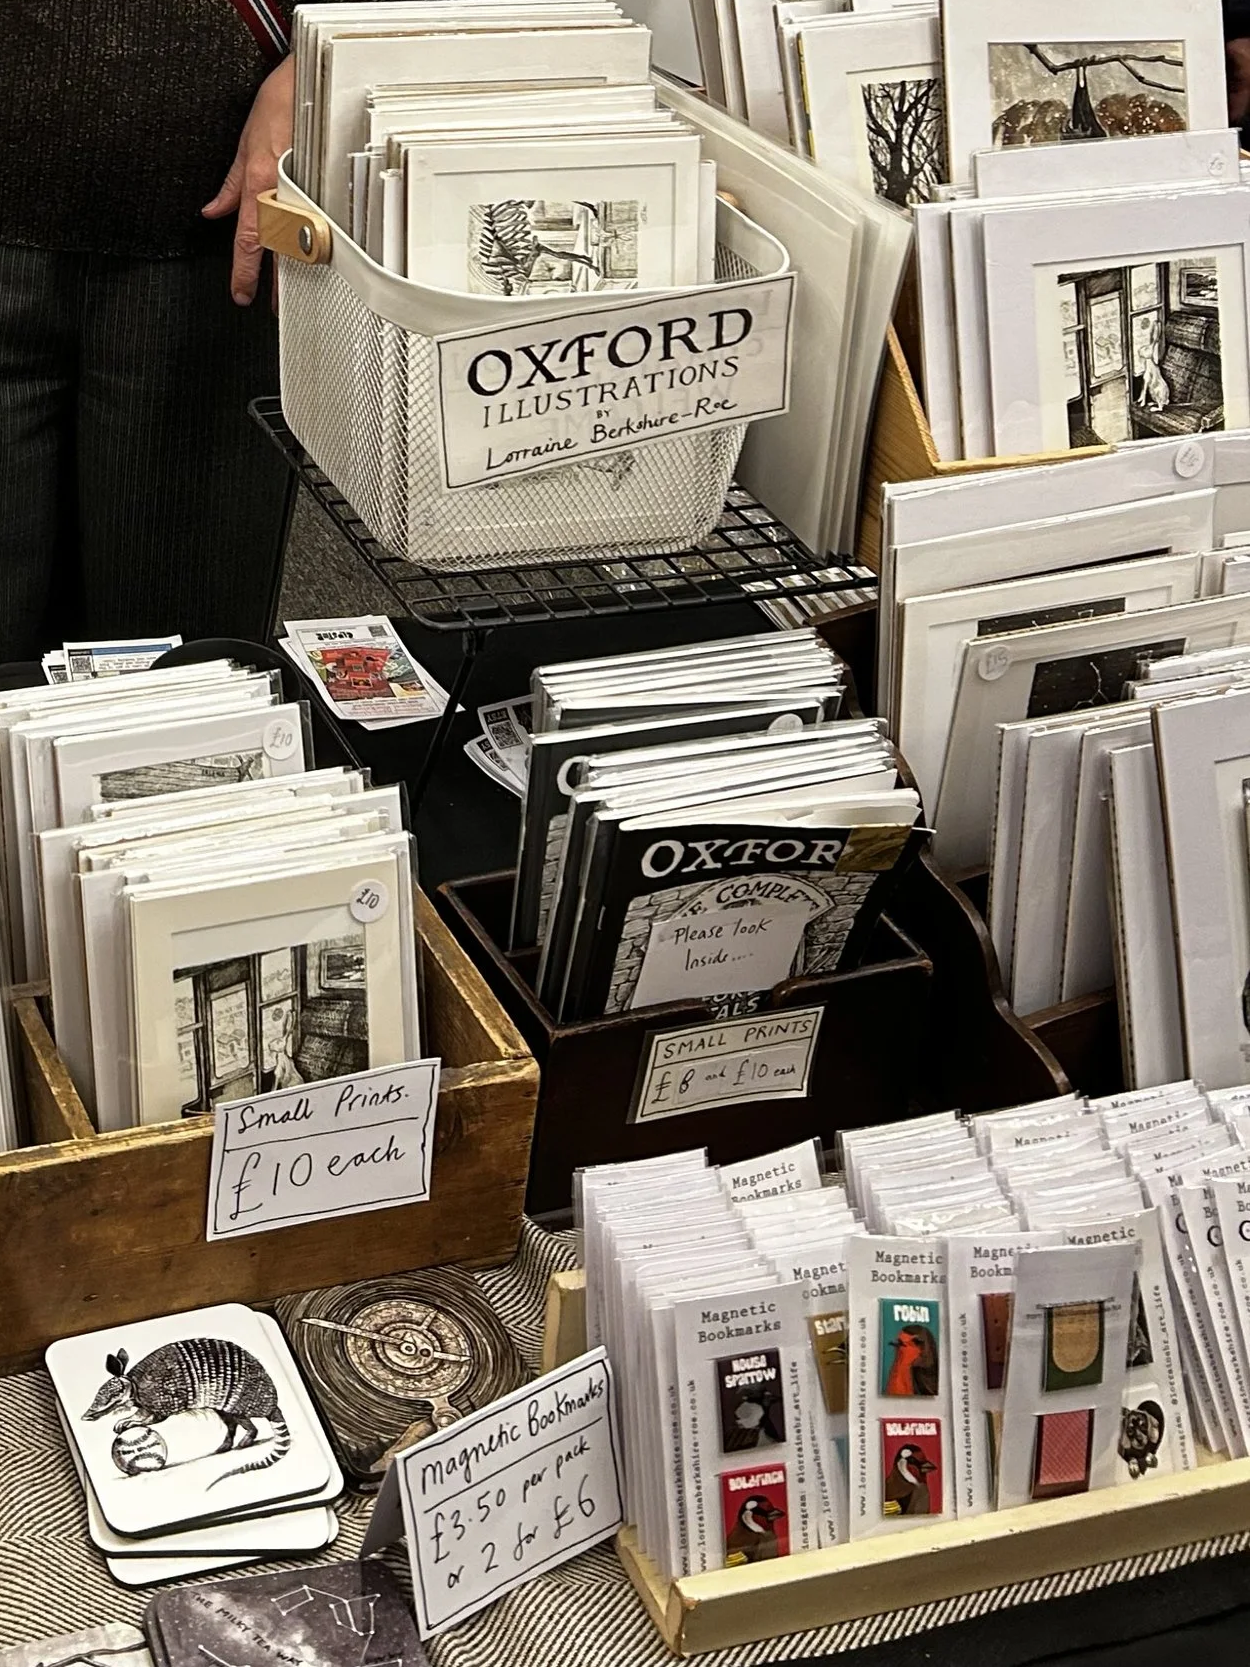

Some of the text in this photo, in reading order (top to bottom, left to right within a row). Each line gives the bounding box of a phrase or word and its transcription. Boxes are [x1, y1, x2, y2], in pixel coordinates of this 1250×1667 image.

[467, 308, 753, 397] OXFORD
[483, 356, 740, 429] ILLUSTRATIONS
[596, 408, 611, 419] BY
[485, 396, 738, 471] Lorraine Berkshire-Roe
[641, 838, 843, 878] OXFOR
[356, 888, 380, 910] £10
[674, 917, 773, 945] Please look
[663, 1019, 813, 1059] SMALL PRINTS
[705, 1065, 726, 1081] and
[733, 1059, 769, 1086] £10
[773, 1065, 796, 1077] each
[237, 1097, 313, 1134] Small
[229, 1134, 406, 1220] £10 each
[732, 1161, 796, 1189] Magnetic
[793, 1260, 846, 1282] Magnet
[875, 1250, 943, 1266] Magnetic
[970, 1265, 1014, 1279] Bookm
[870, 1269, 947, 1285] Bookmarks
[701, 1300, 777, 1324] Magnetic
[697, 1318, 782, 1344] Bookmarks
[430, 1435, 591, 1564] £3.50 per pack
[447, 1473, 596, 1589] or 2 for £6
[191, 1591, 303, 1667] THE MILKY TEA WAY
